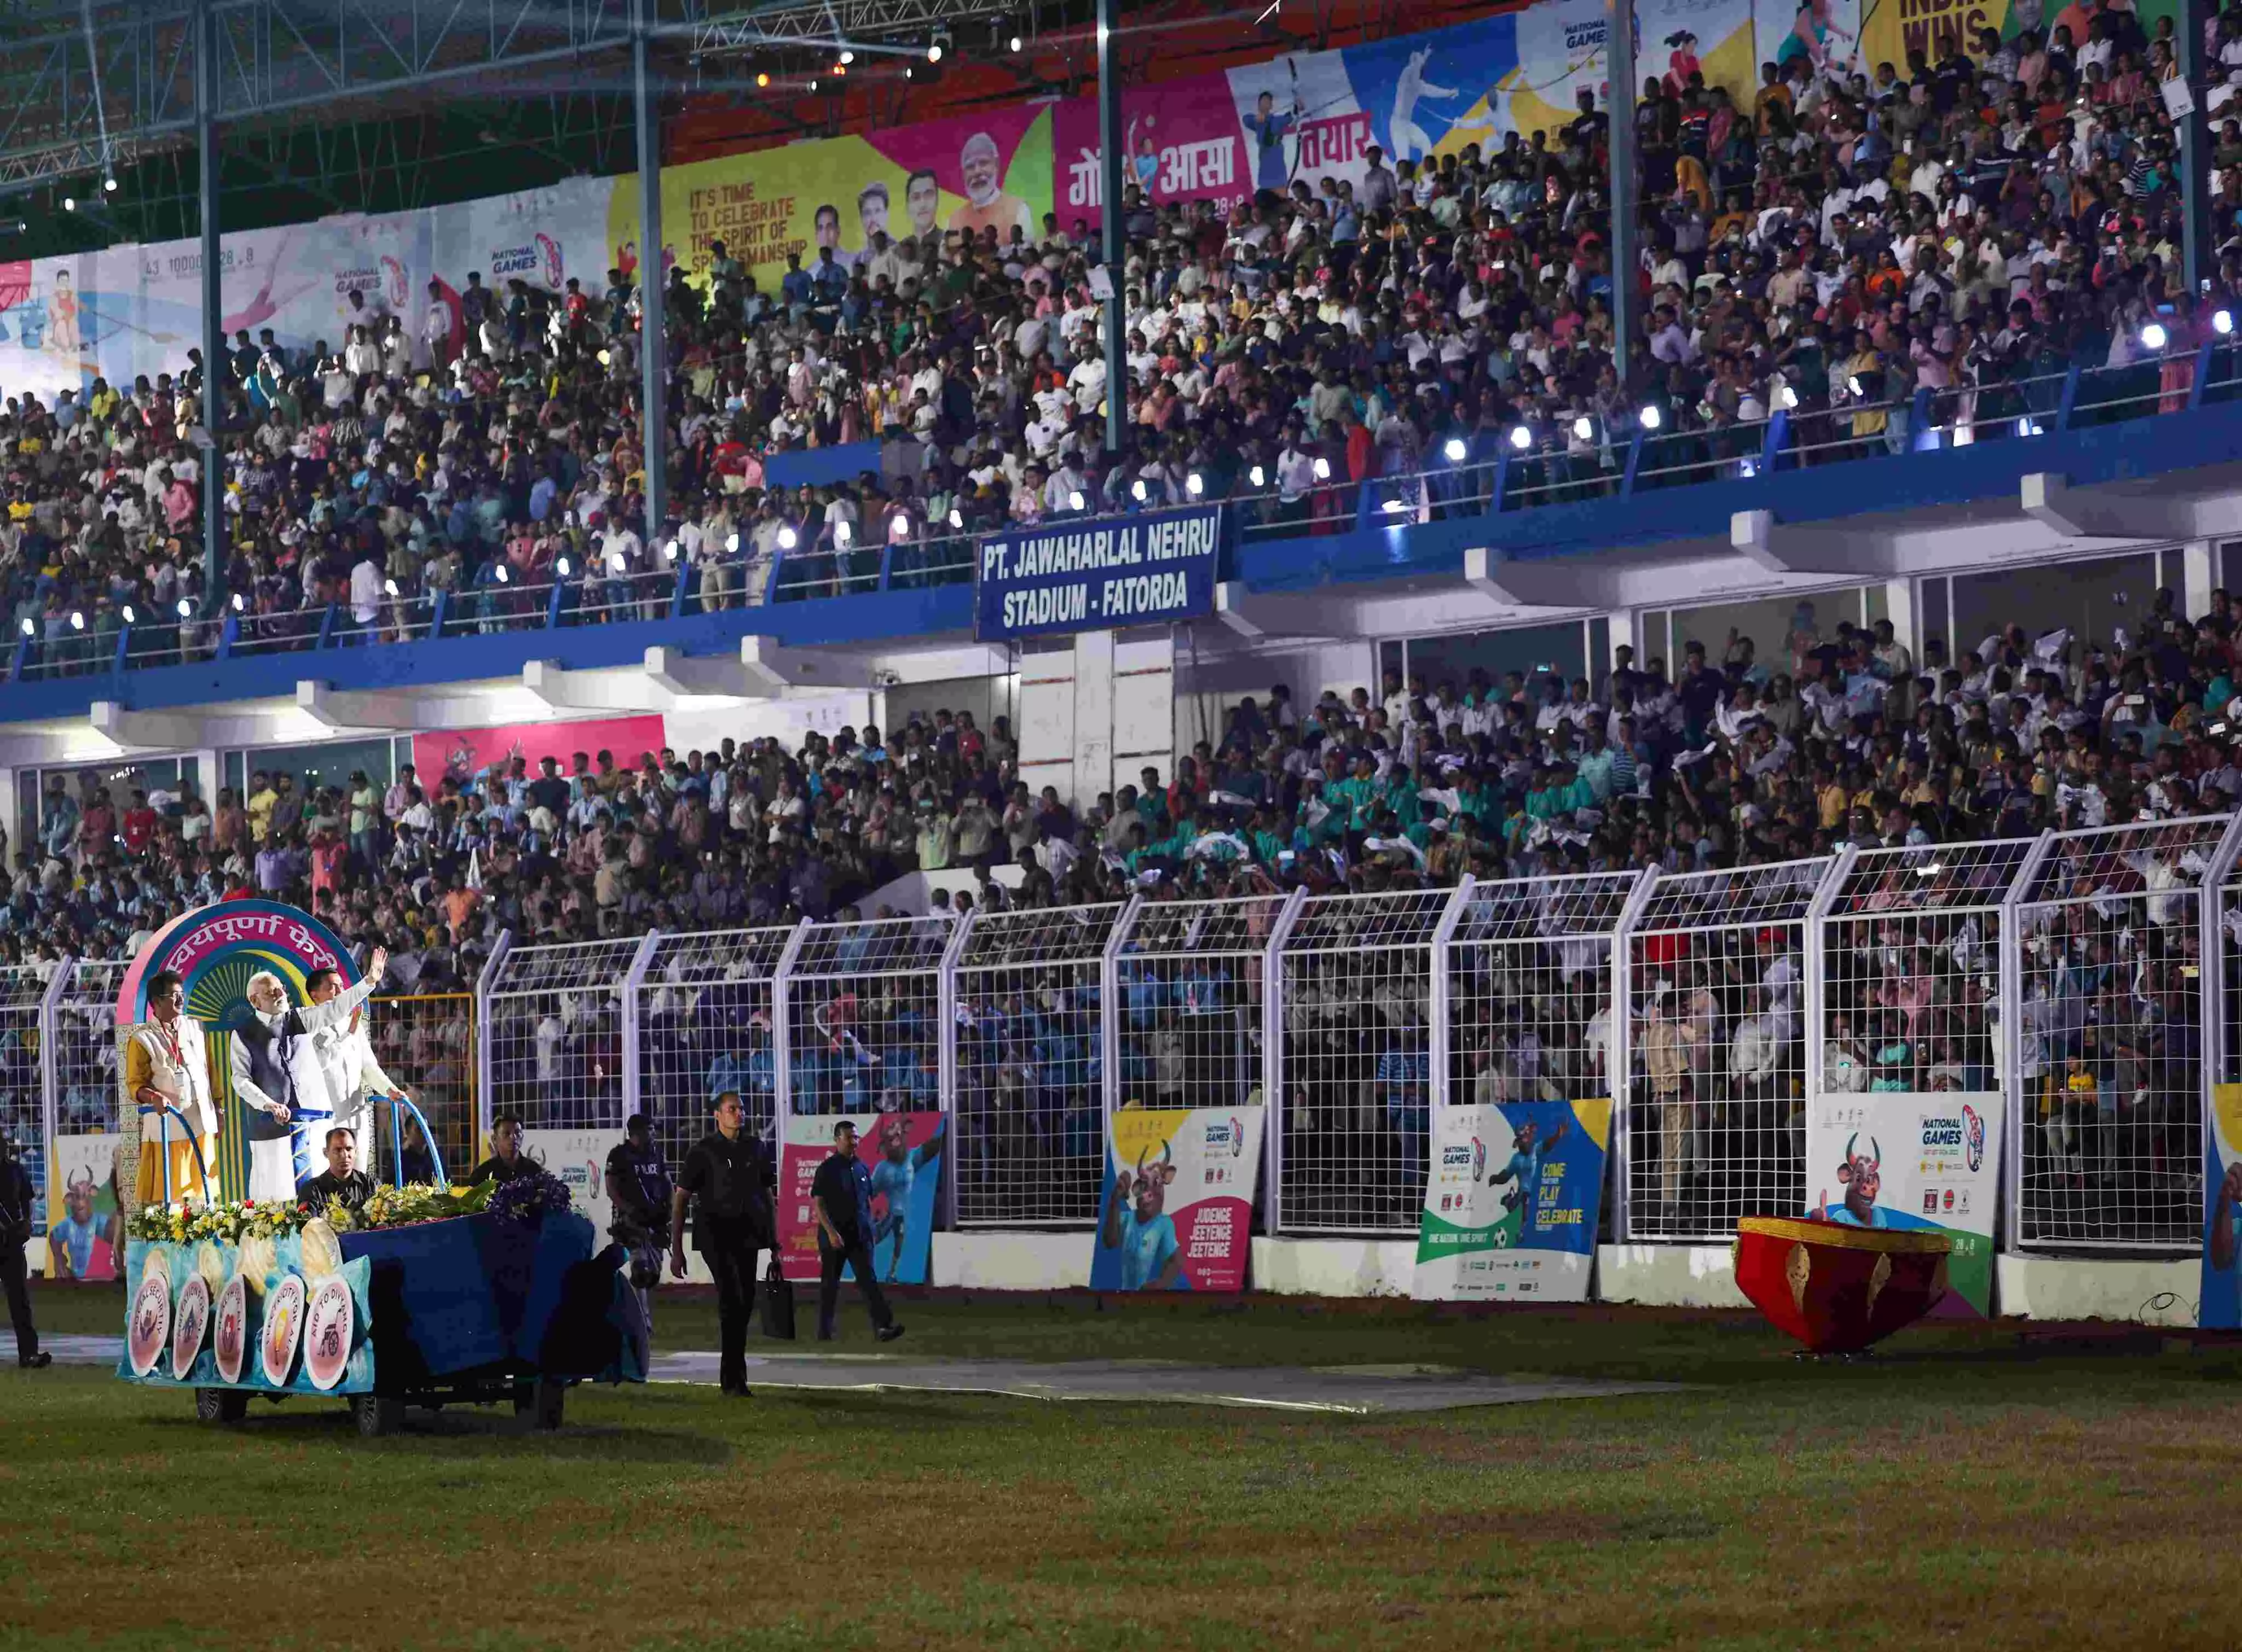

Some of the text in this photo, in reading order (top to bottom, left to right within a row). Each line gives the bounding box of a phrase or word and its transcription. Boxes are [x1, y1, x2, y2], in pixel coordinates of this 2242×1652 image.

[1565, 20, 1607, 35] NATIONA
[1567, 30, 1608, 49] GAME
[1160, 136, 1235, 193] आसा
[721, 182, 754, 204] TIME
[690, 197, 795, 231] TO CELEBRATE
[723, 223, 766, 246] SPIRIT
[770, 220, 788, 240] OF
[492, 246, 534, 260] NATIONAL
[494, 256, 537, 274] GAMES
[336, 276, 382, 293] GAMES
[984, 517, 1215, 582] PT. JAWAHARLAL NEHRU
[1003, 583, 1087, 628] STADIUM
[1102, 571, 1187, 617] FATORDA
[1922, 1118, 1961, 1128] NATIONAL
[1206, 1133, 1230, 1142] GAMES
[1923, 1130, 1962, 1145] GAMES
[1443, 1153, 1471, 1164] GAMES
[1539, 1186, 1561, 1200] PLAY
[311, 1313, 320, 1337] AID
[320, 1293, 329, 1309] TO
